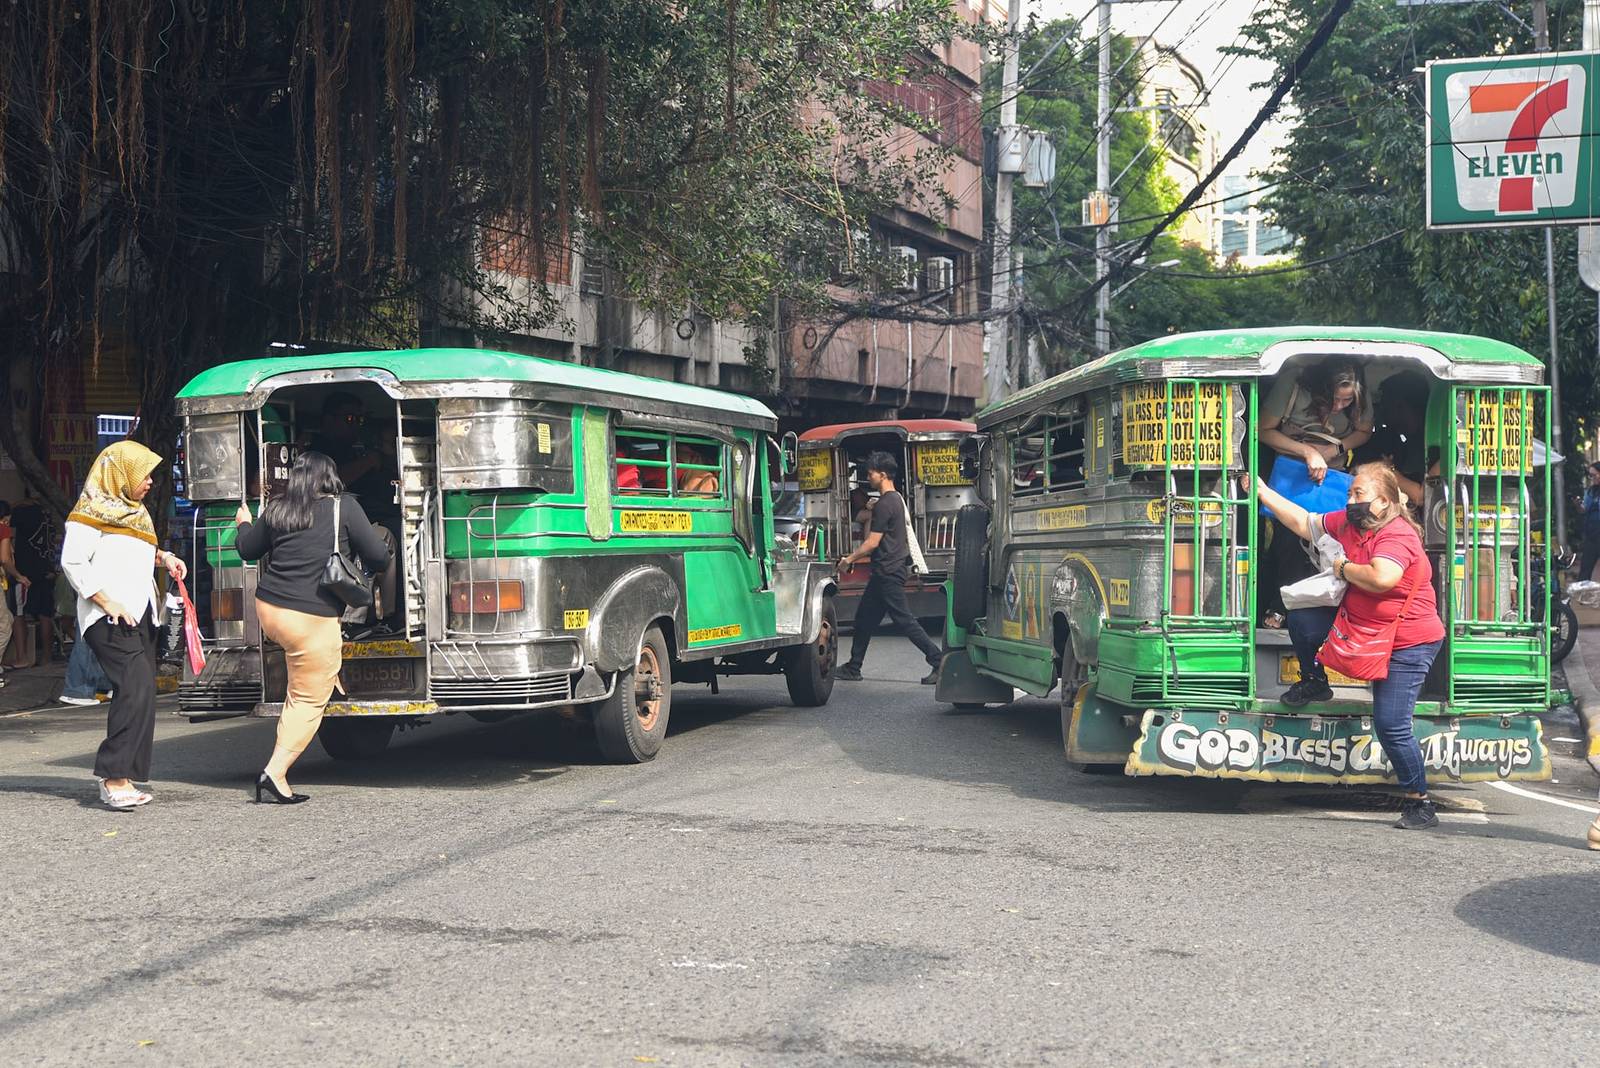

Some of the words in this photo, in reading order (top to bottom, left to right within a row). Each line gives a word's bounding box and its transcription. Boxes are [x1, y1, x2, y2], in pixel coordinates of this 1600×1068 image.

[1469, 78, 1568, 212] 7
[1153, 382, 1193, 400] HOLINE
[1203, 382, 1222, 399] 134
[1503, 407, 1520, 426] ASS
[1139, 423, 1163, 442] VIBER
[1171, 422, 1222, 441] OTLNES
[1469, 428, 1495, 445] TXT
[1505, 428, 1528, 446] VIBR
[1160, 722, 1259, 771] GOD
[1349, 734, 1393, 772] U
